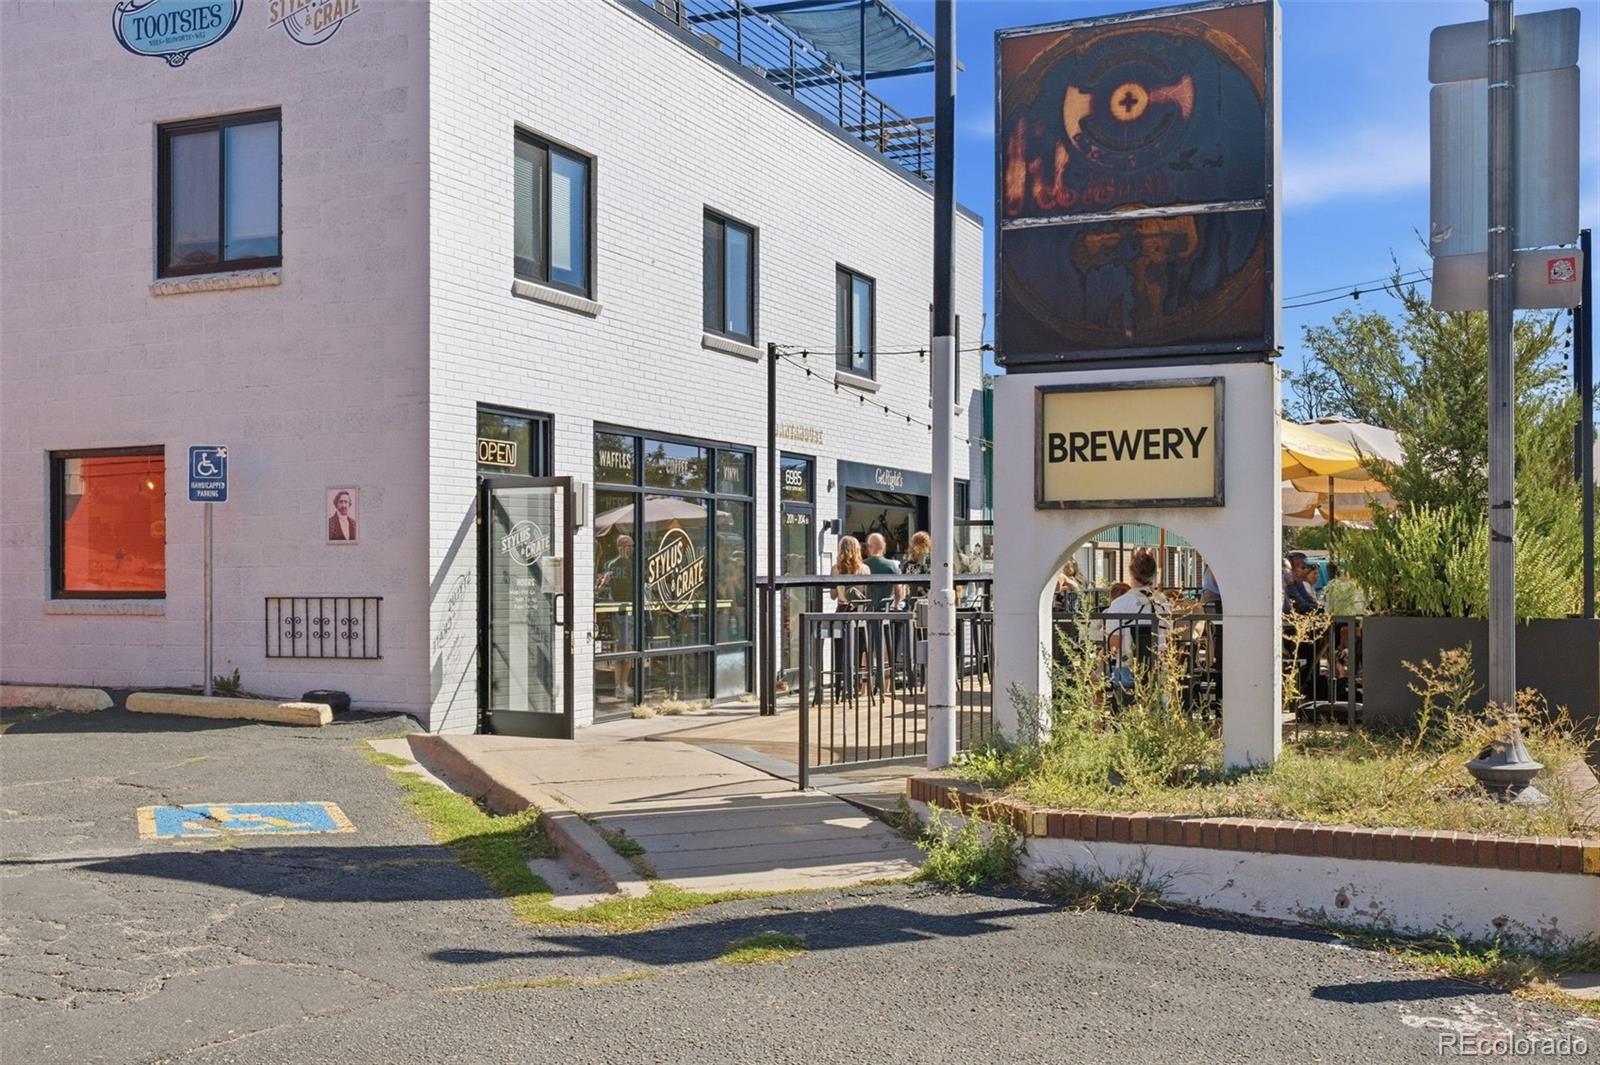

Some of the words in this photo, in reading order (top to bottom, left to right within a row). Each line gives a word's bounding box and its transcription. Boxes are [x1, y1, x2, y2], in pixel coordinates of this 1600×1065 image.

[133, 4, 222, 40] TOOTSIES
[479, 441, 515, 464] OPEN
[1048, 426, 1208, 463] BREWERY
[599, 450, 631, 470] WAFFLES
[665, 458, 688, 475] COFFEE
[191, 481, 225, 489] HANDICAPPED
[501, 527, 531, 551] STYLUS
[525, 536, 551, 557] CRATE
[648, 541, 683, 583] STYLUS
[676, 560, 704, 597] CRATE
